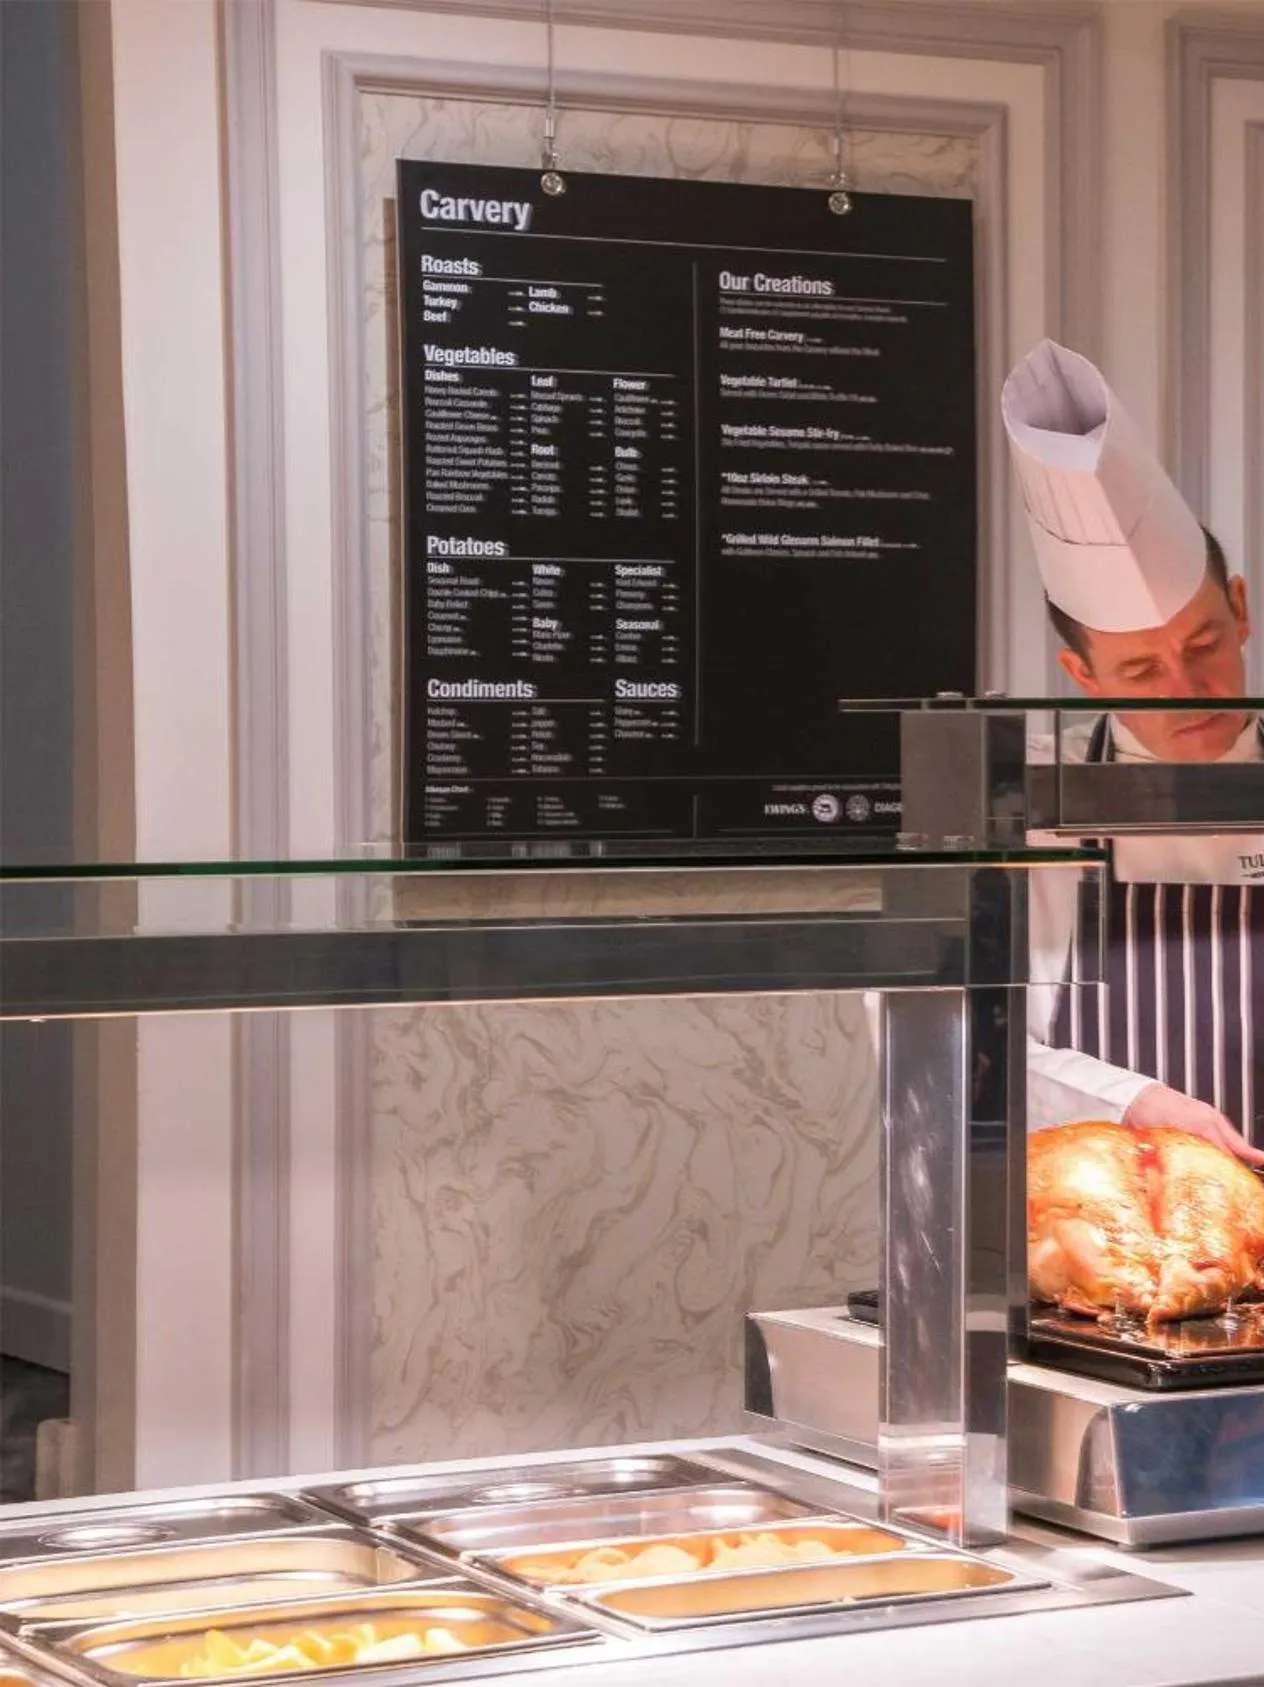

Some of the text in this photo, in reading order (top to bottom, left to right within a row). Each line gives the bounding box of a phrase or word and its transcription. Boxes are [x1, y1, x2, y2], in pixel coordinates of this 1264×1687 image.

[420, 188, 531, 231] Carvery
[421, 255, 480, 275] Roasts
[423, 280, 469, 293] Gammon
[719, 271, 834, 296] Our Creations
[529, 286, 557, 298] Lamb
[423, 295, 458, 309] Turkey
[529, 301, 570, 314] Chicken
[423, 310, 447, 322] Beef
[719, 326, 744, 339] Meat
[745, 327, 766, 340] Free
[767, 328, 805, 344] Carvery
[424, 344, 516, 366] Vegetables
[424, 369, 461, 382] Dishes
[531, 375, 554, 388] Leaf
[720, 373, 767, 388] Vegetable
[613, 378, 648, 391] Flower
[720, 424, 767, 437] Vegetable
[531, 444, 555, 456] Root
[427, 535, 506, 556] Potatoes
[427, 562, 451, 574] Dish
[532, 564, 562, 576] White
[614, 564, 662, 577] Specialist
[532, 617, 559, 631] Baby
[615, 617, 660, 631] Seasonal
[427, 678, 535, 698] Condiments
[615, 679, 678, 698] Sauces
